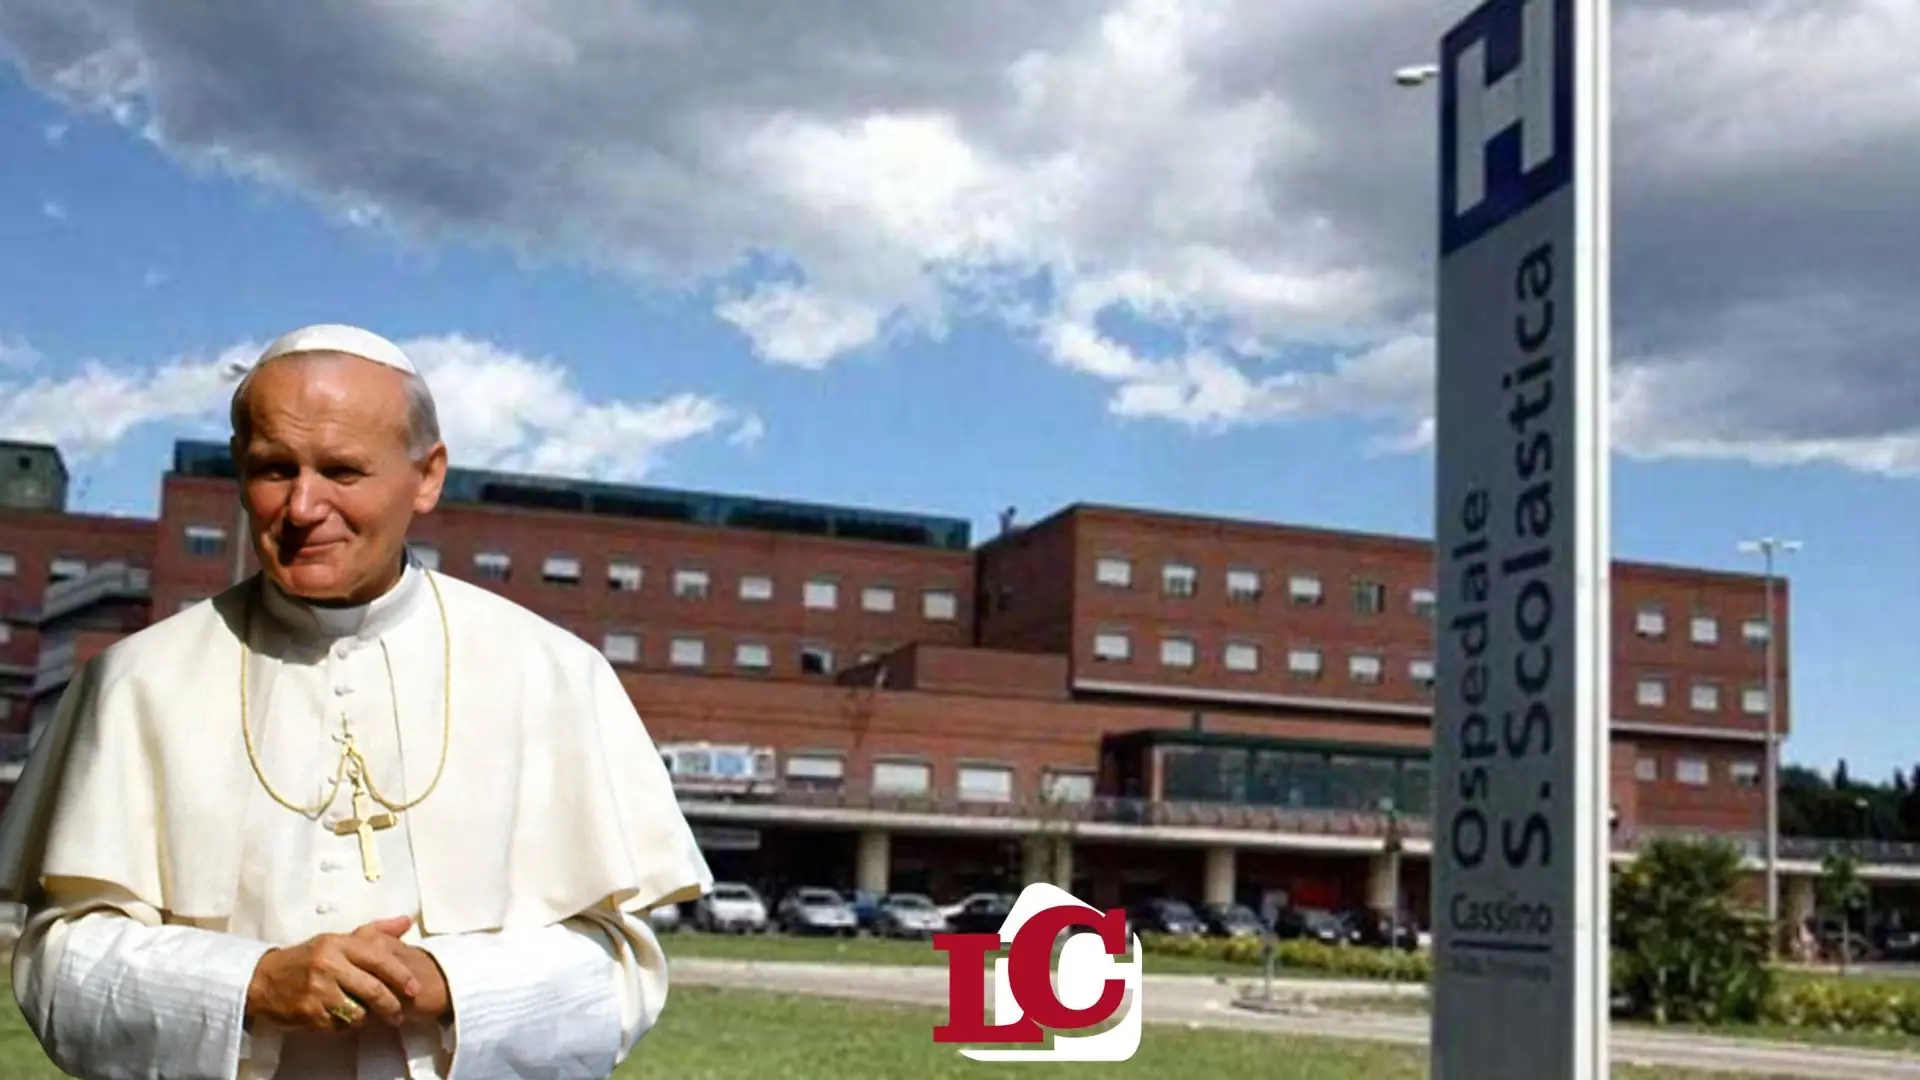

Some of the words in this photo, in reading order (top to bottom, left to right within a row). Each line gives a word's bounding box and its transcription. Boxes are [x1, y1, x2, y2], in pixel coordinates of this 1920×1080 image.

[1456, 0, 1555, 217] H
[1503, 242, 1554, 758] Scolastica
[1450, 488, 1496, 869] Ospedale
[1450, 891, 1554, 935] Cassino
